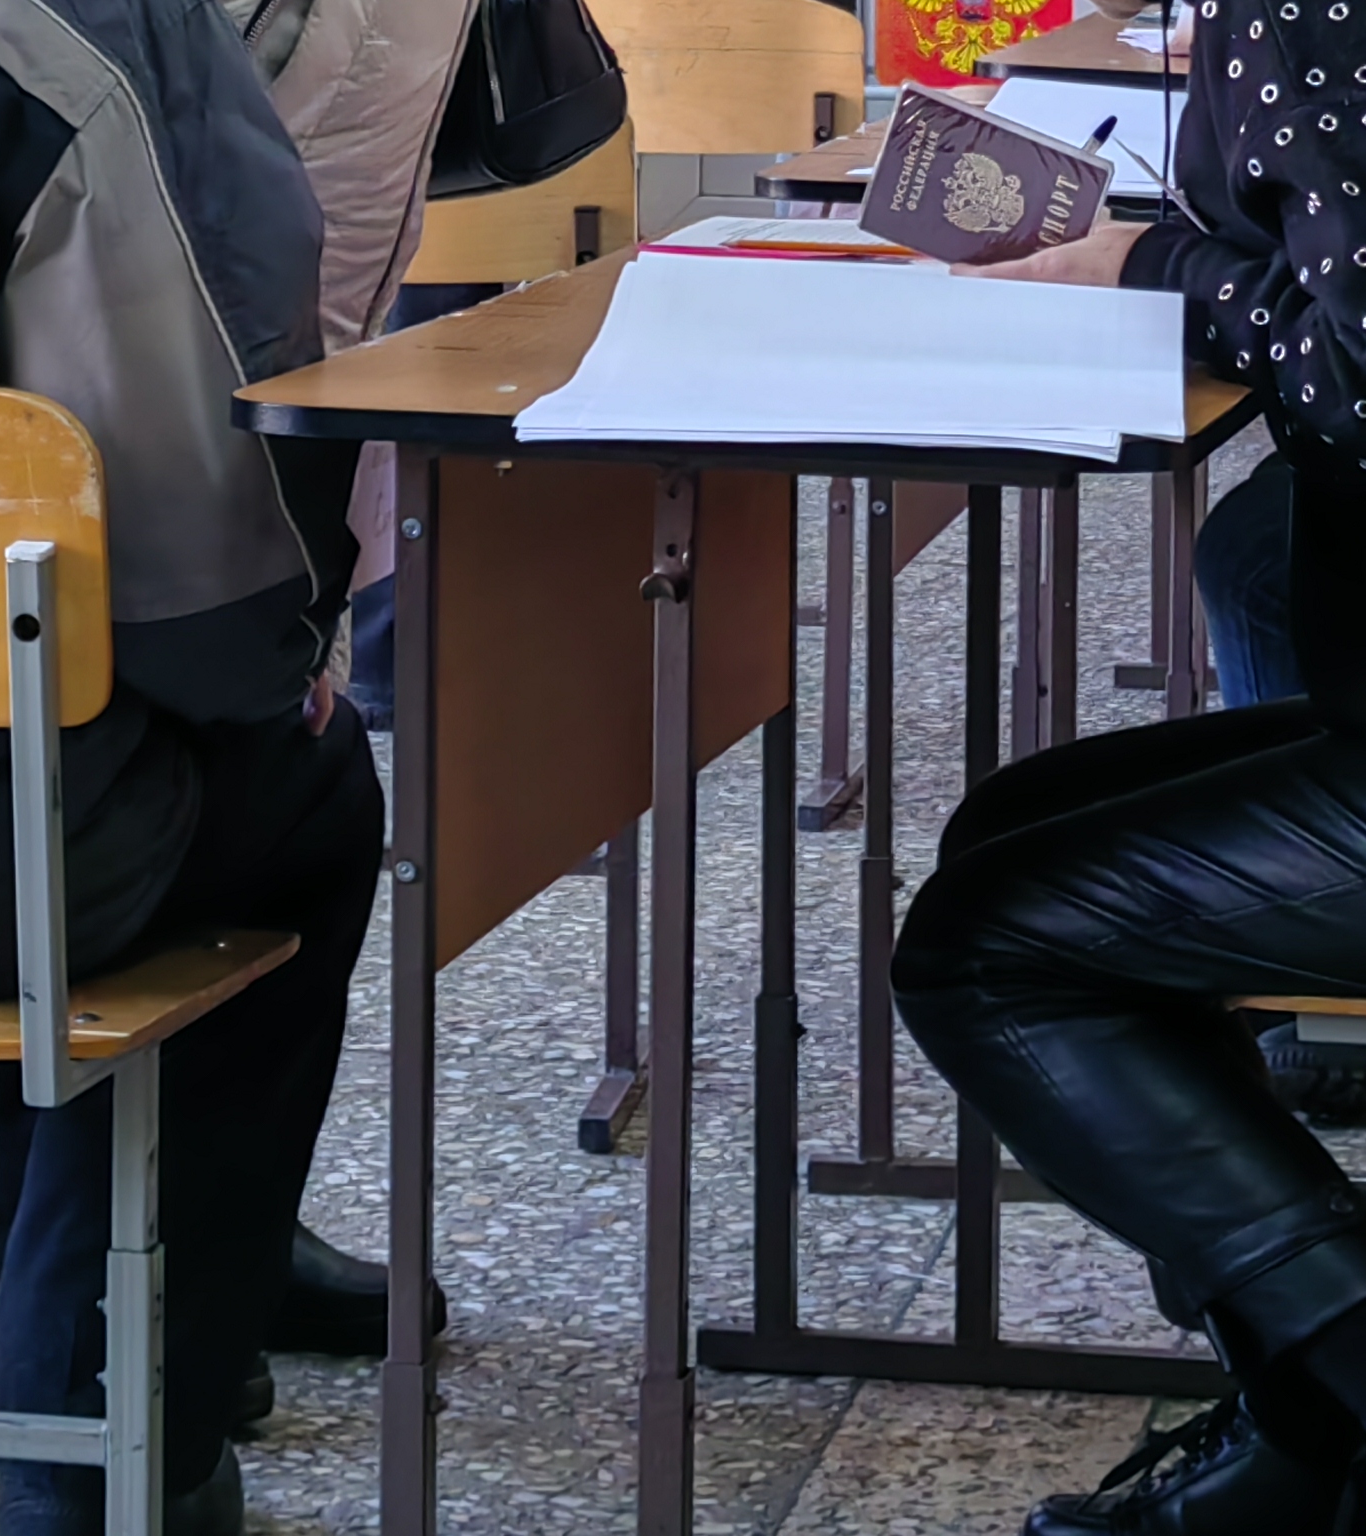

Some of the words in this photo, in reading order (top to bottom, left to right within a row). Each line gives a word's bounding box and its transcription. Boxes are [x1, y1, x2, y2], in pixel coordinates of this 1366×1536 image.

[890, 118, 927, 212] РОССИЙСКАЯ
[907, 131, 940, 211] ФЕДЕРАЦИЯ
[1038, 175, 1080, 248] СПОРТ
